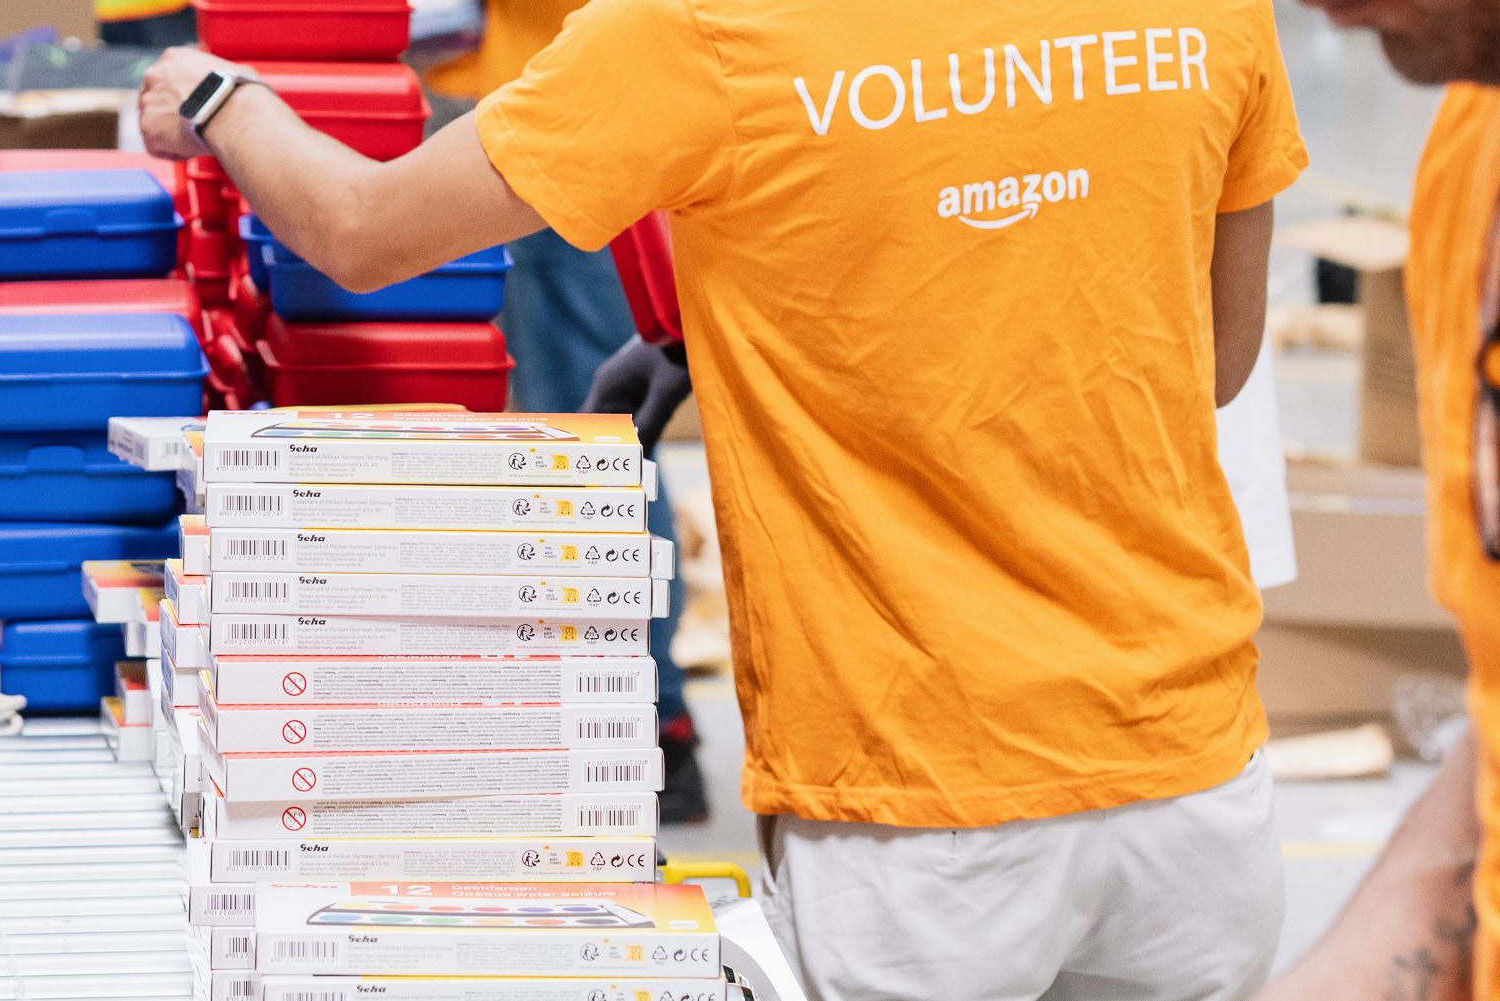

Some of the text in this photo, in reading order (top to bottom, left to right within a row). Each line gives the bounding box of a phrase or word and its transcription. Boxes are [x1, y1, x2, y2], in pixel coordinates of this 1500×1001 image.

[793, 27, 1209, 136] VOLUNTEER
[937, 167, 1090, 219] amazon
[381, 884, 433, 896] 12
